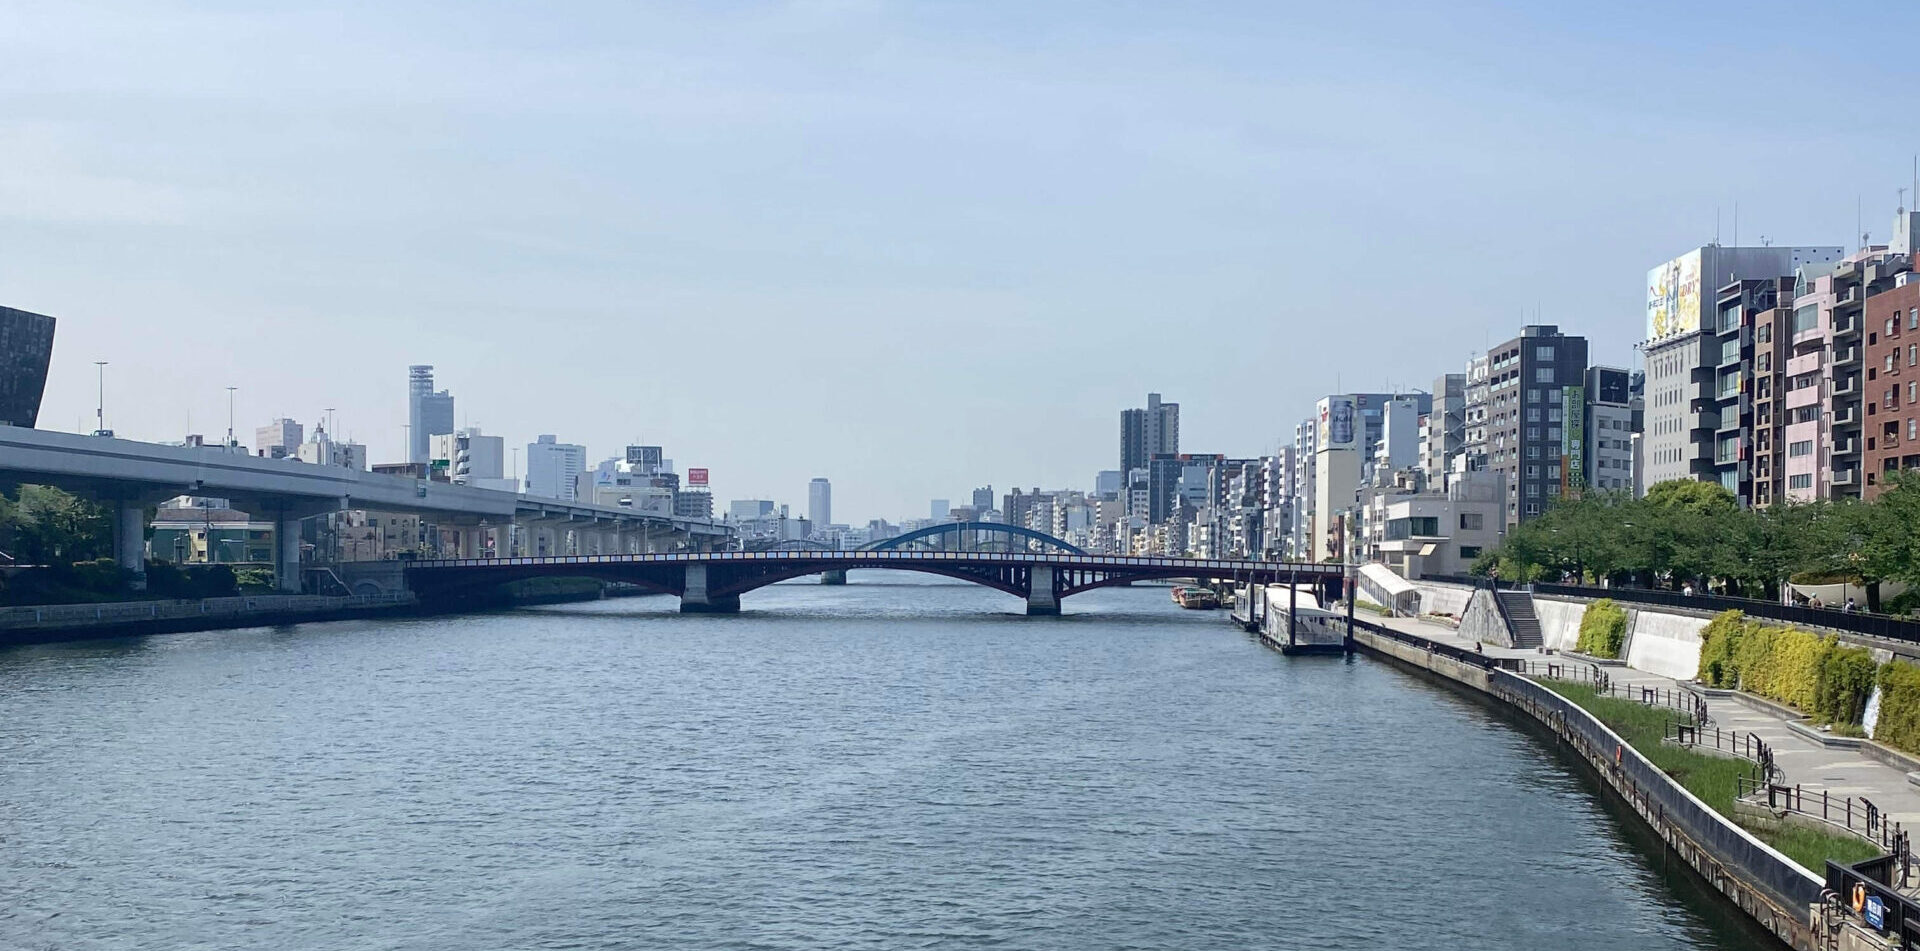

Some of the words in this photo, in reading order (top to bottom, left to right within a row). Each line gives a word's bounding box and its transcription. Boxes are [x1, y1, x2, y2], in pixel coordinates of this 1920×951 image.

[1571, 390, 1581, 469] お部屋探し専門店
